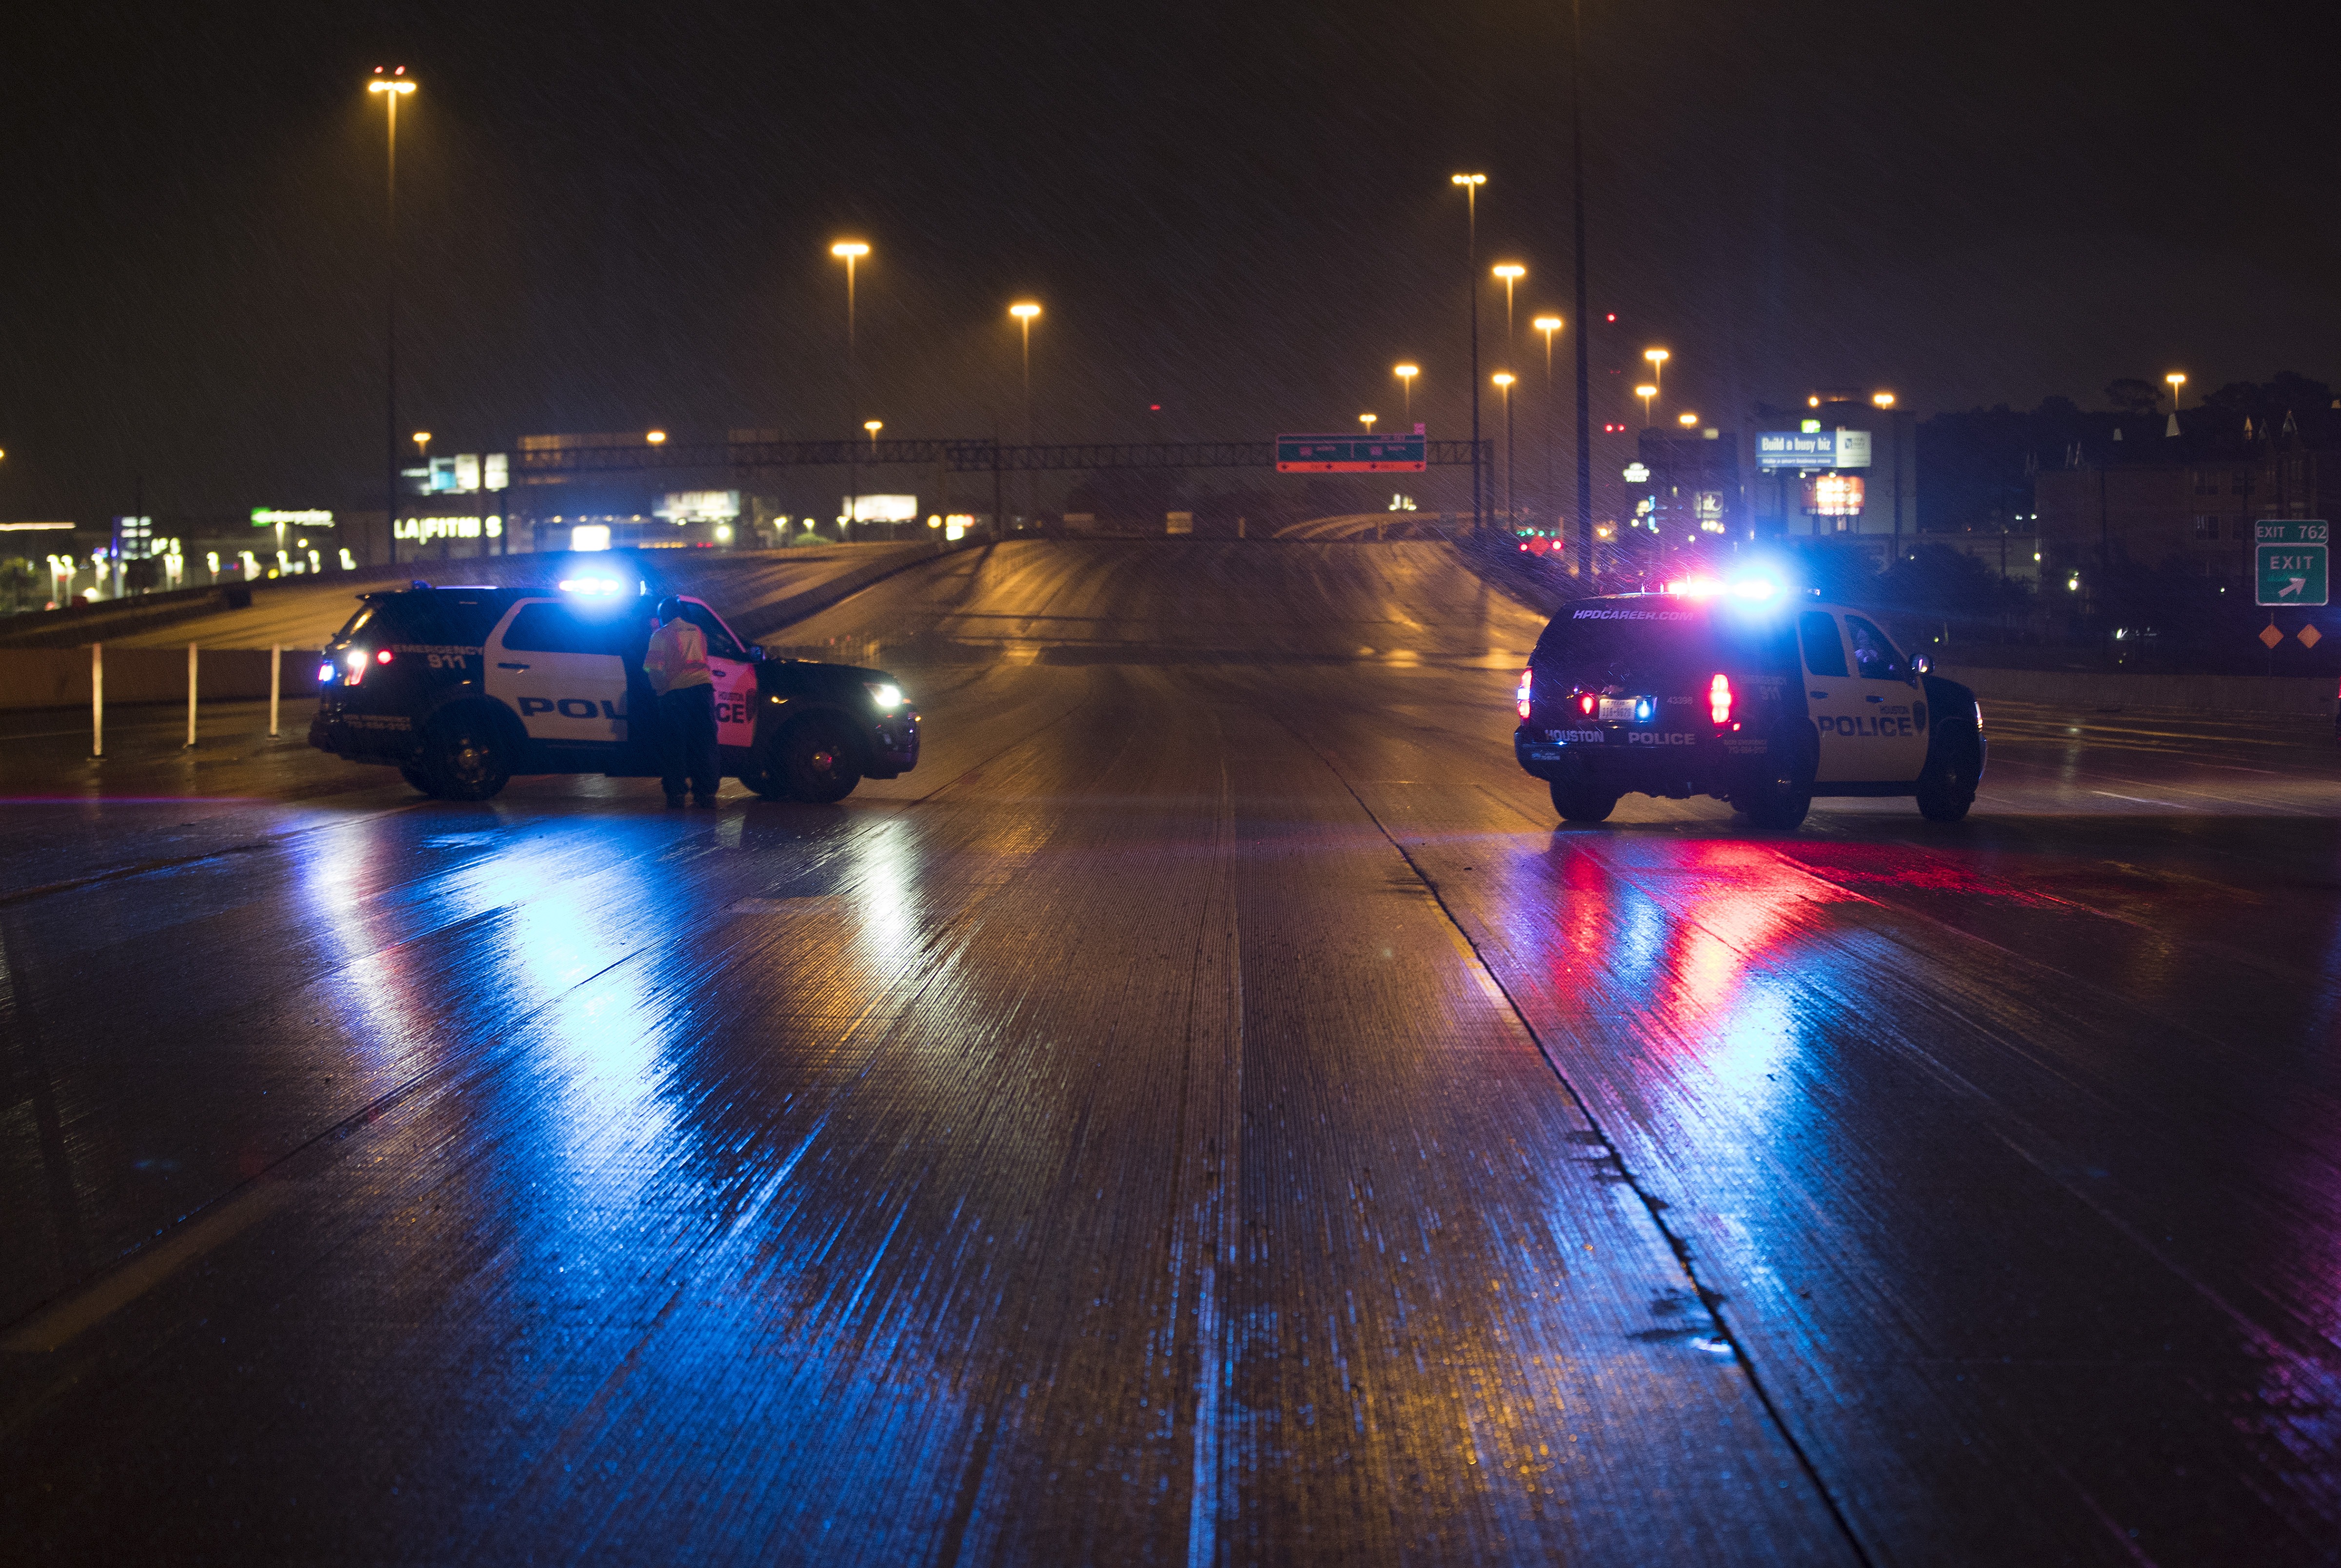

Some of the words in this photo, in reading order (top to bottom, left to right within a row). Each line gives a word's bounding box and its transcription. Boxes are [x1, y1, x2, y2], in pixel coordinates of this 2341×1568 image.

[1762, 437, 1784, 451] Build
[1786, 440, 1793, 451] a
[1794, 437, 1816, 453] busy
[1818, 437, 1831, 451] biz
[394, 518, 419, 538] LA
[2256, 526, 2285, 538] EXIT
[2298, 525, 2327, 539] 762
[2270, 555, 2315, 569] EXIT
[1572, 609, 1694, 620] HPDCAREER.COM
[427, 654, 467, 669] 911
[1817, 715, 1913, 737] POLICE
[1544, 729, 1605, 743] HOUSTON
[1628, 731, 1696, 745] POLICE
